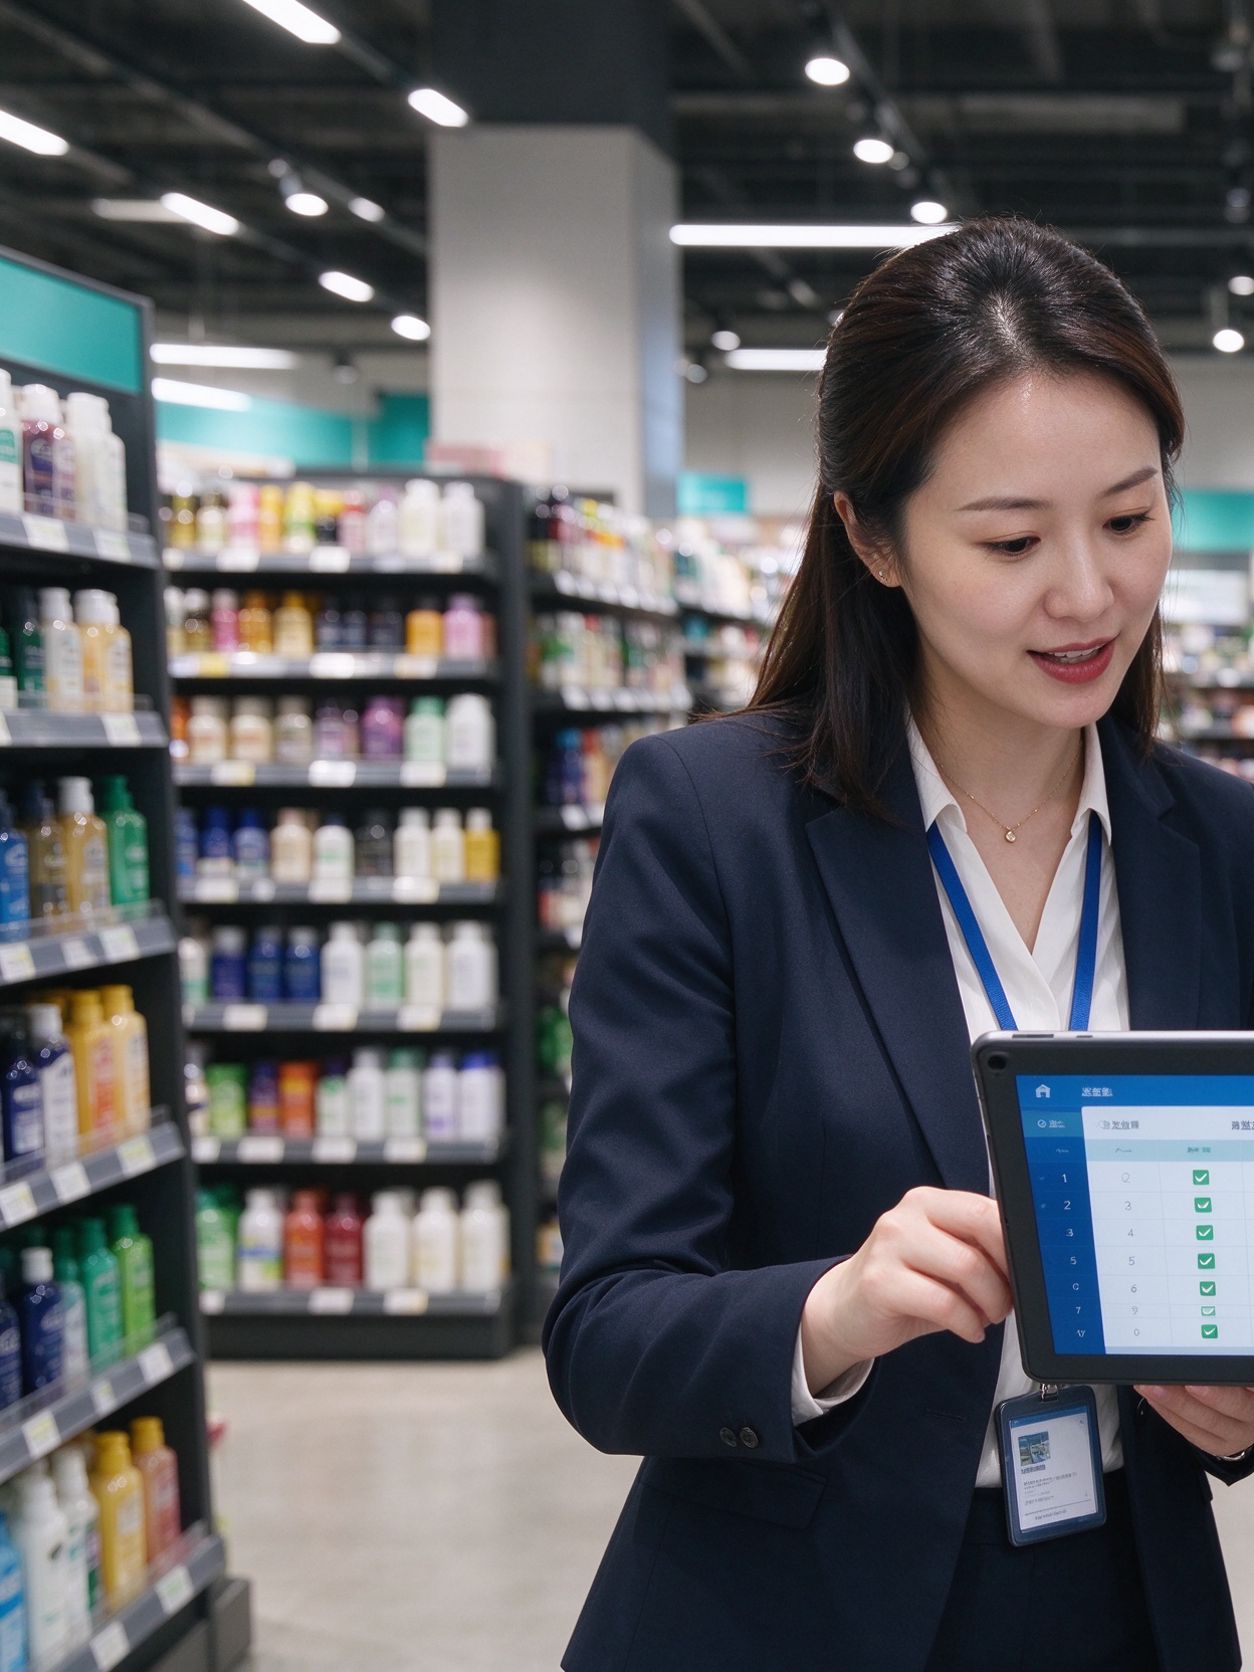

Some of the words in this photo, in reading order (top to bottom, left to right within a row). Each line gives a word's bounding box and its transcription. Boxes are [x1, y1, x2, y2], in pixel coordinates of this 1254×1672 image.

[1062, 1173, 1068, 1183] 1
[1064, 1200, 1071, 1210] 2
[1066, 1228, 1074, 1237] 3
[1127, 1228, 1134, 1237] 4
[1070, 1256, 1077, 1265] 5
[1128, 1256, 1136, 1266] 5
[1130, 1284, 1138, 1293] 6
[1075, 1306, 1081, 1315] 7
